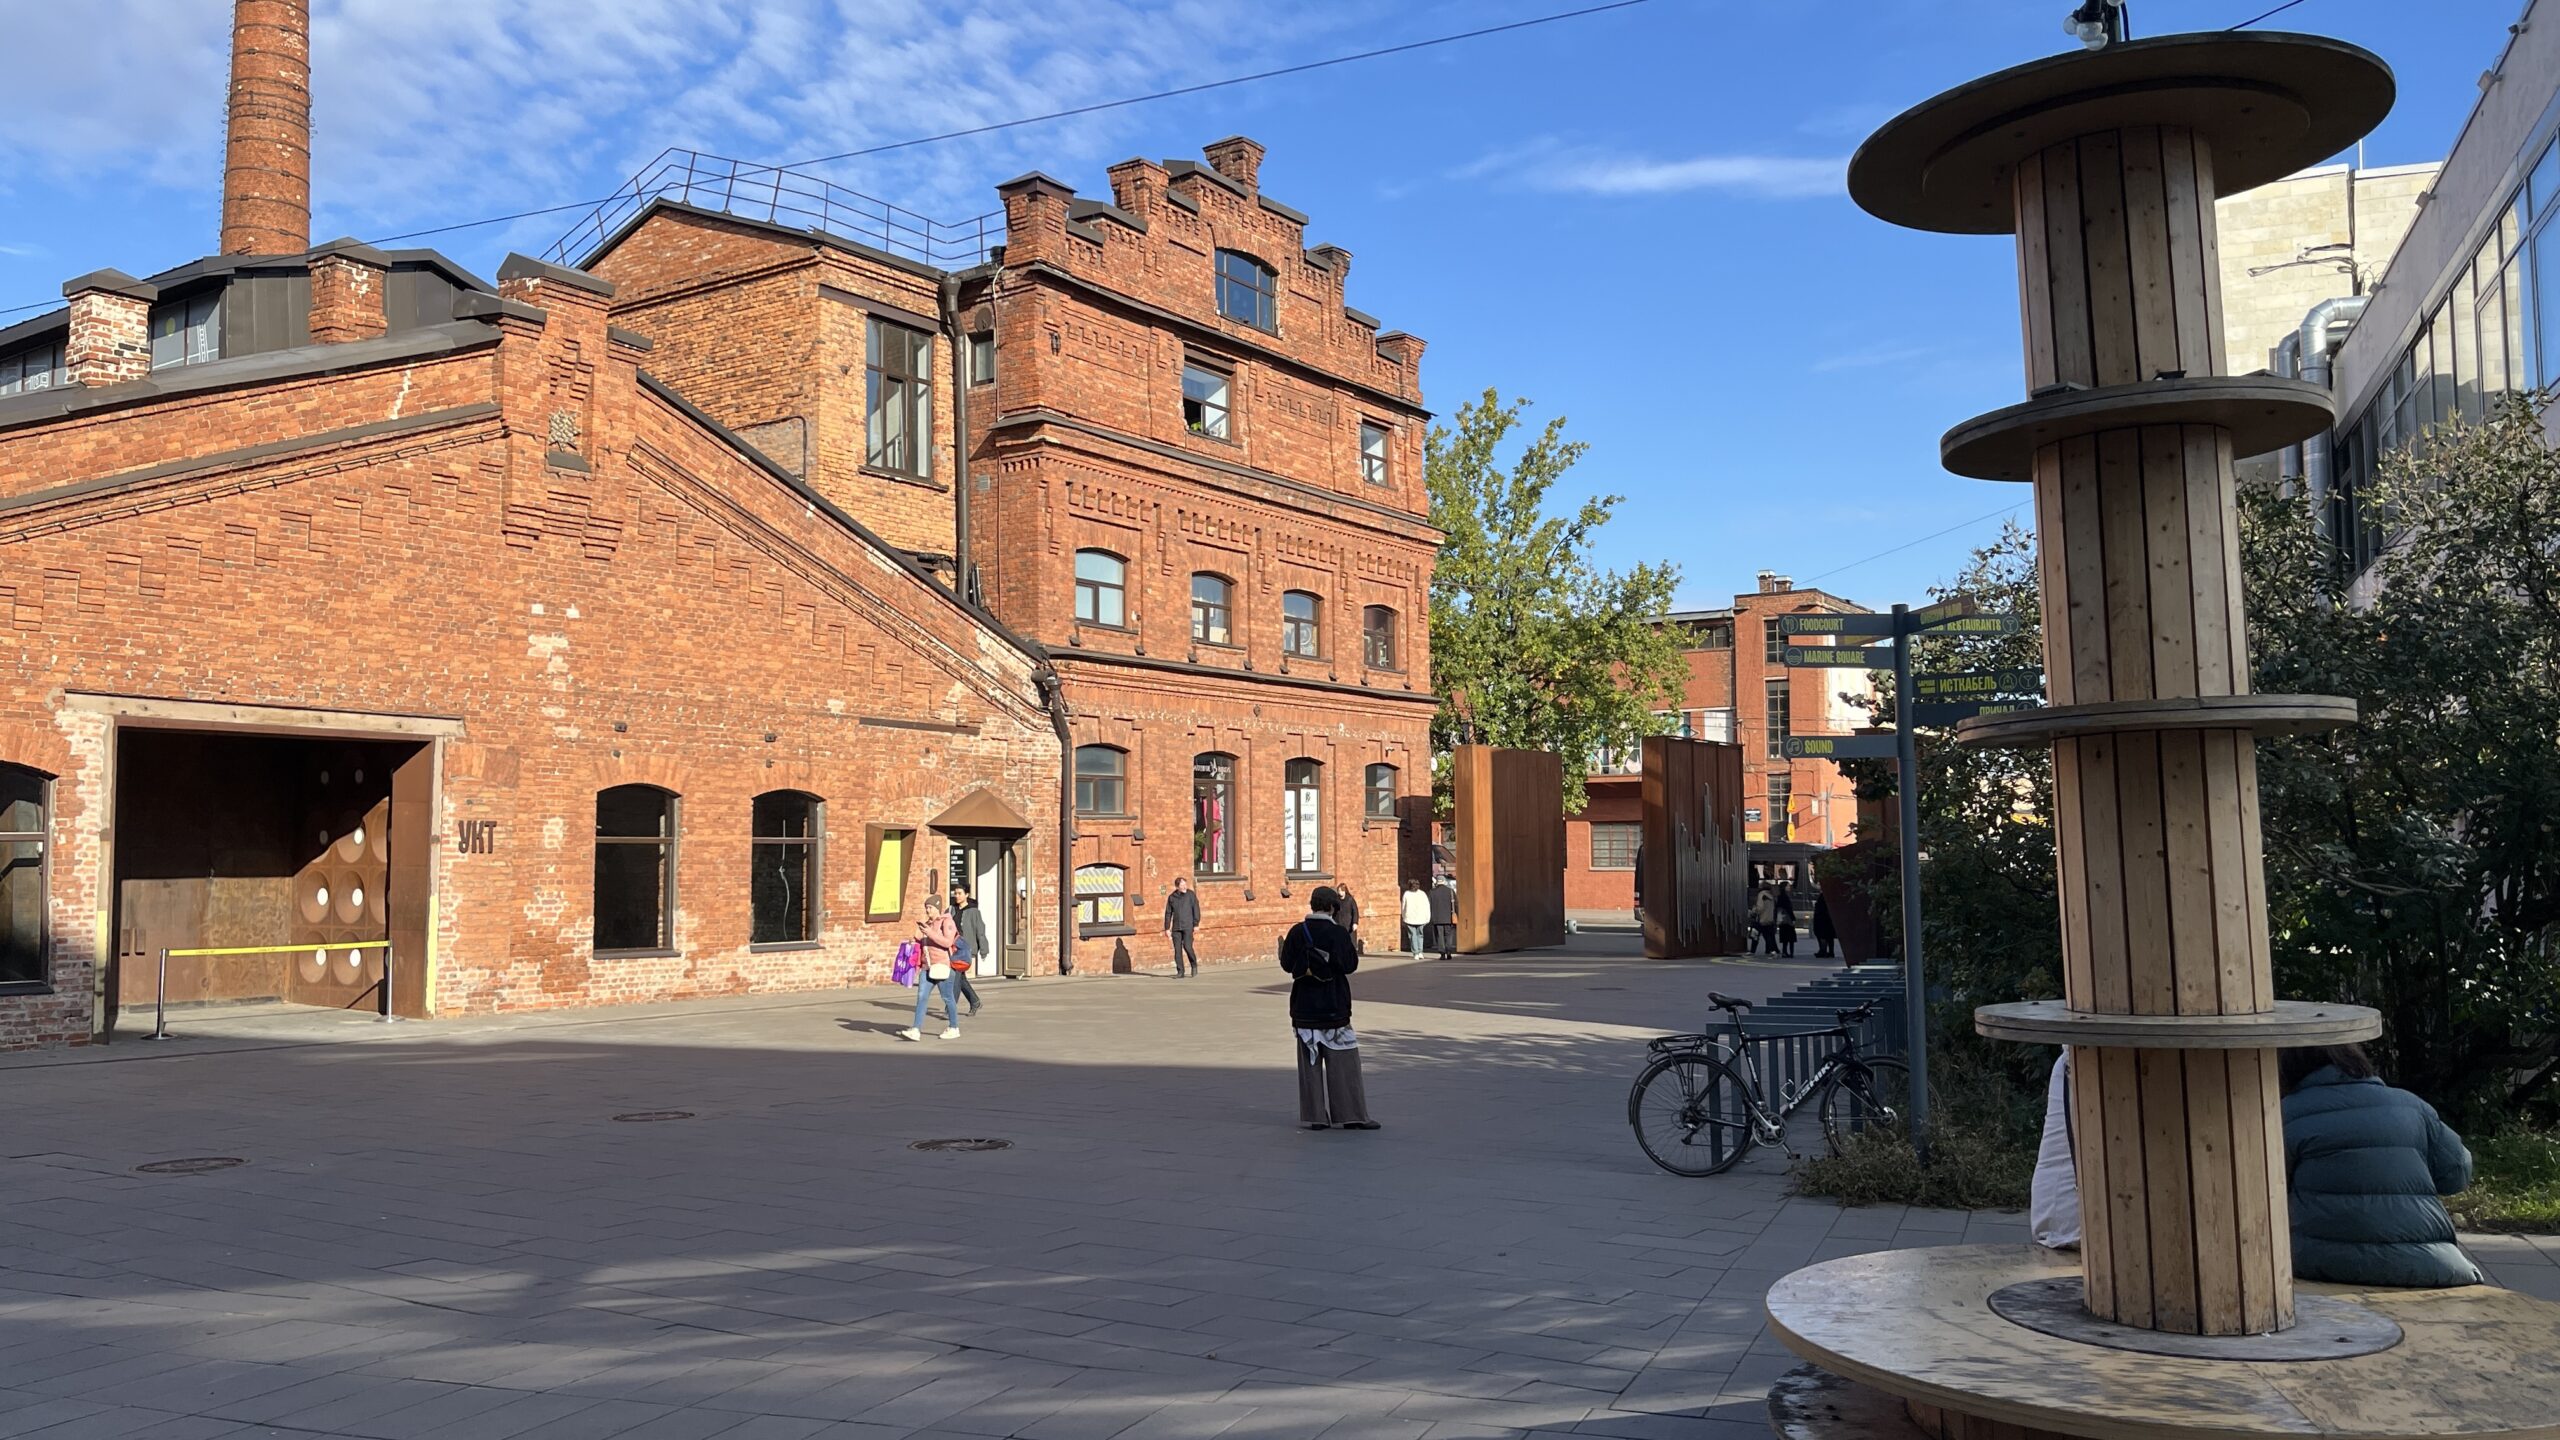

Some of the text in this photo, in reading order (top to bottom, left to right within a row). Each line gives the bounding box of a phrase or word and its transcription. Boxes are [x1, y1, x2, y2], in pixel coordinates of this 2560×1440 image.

[1799, 618, 1844, 631] FOODCOURT
[1803, 650, 1865, 664] MARINE SQUARE
[1939, 675, 1997, 693] ИСТКАБЕЛЬ
[1804, 739, 1834, 754] SOUND
